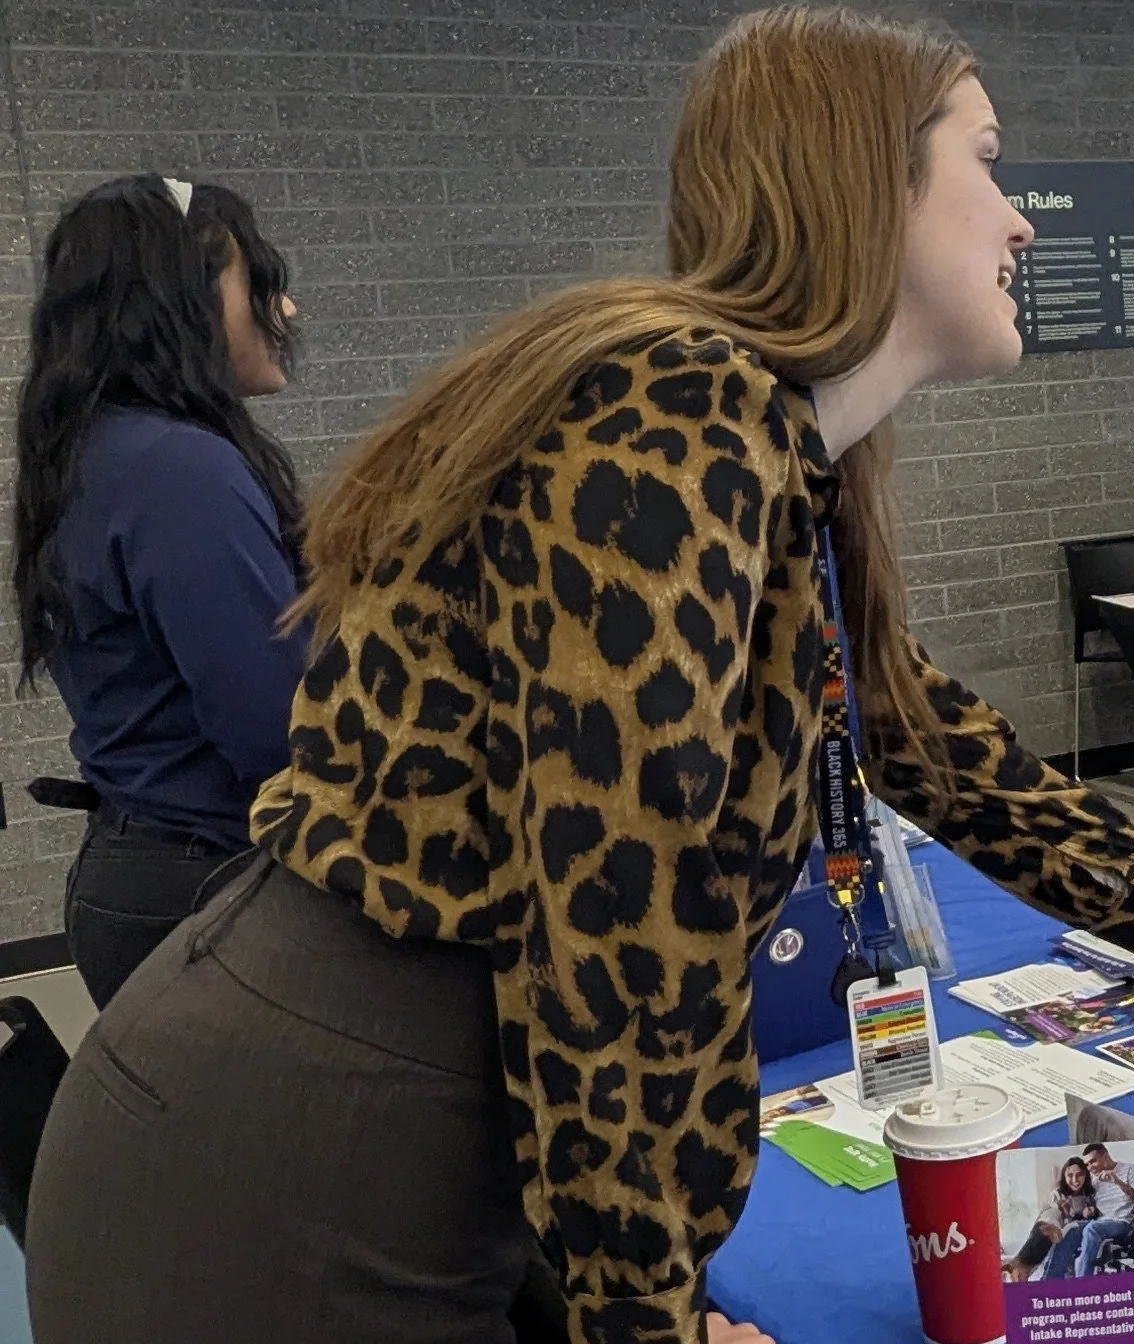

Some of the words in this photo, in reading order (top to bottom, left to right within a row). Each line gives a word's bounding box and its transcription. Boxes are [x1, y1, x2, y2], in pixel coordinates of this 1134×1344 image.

[1028, 191, 1073, 209] Rules
[827, 741, 842, 777] BLACK
[829, 778, 845, 825] HISTORY
[832, 827, 847, 848] 365
[1032, 1298, 1044, 1309] To
[1045, 1297, 1072, 1309] learn
[1074, 1295, 1101, 1306] more
[1103, 1291, 1131, 1304] about
[1021, 1315, 1068, 1327] program,
[1070, 1311, 1103, 1323] please
[1030, 1329, 1063, 1341] Intake
